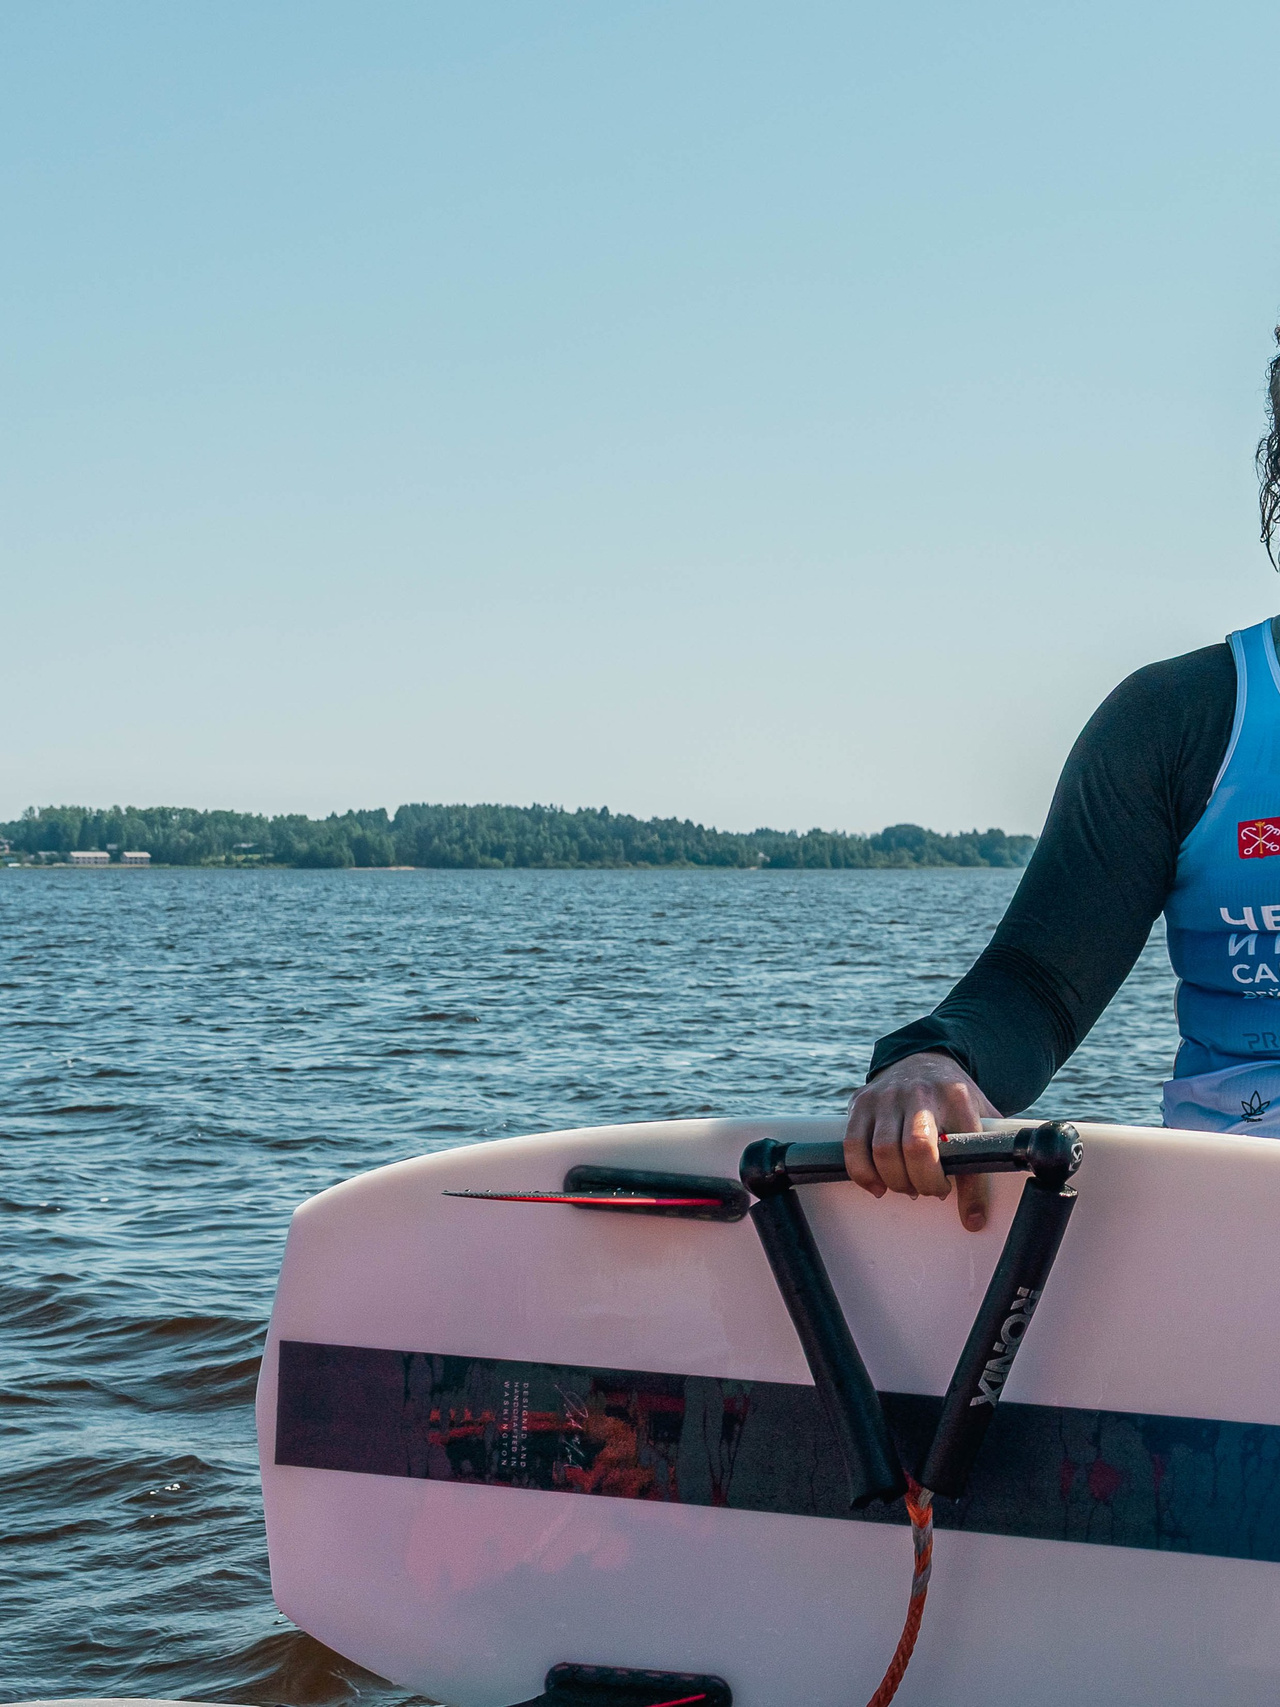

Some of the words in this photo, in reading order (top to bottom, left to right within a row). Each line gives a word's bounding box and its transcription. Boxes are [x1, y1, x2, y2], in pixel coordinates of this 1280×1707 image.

[1228, 933, 1256, 956] И
[501, 1381, 510, 1466] WASHINGTON
[511, 1382, 519, 1452] HANDCRAFTED
[521, 1382, 529, 1439] DESIGNED
[510, 1456, 517, 1467] IN
